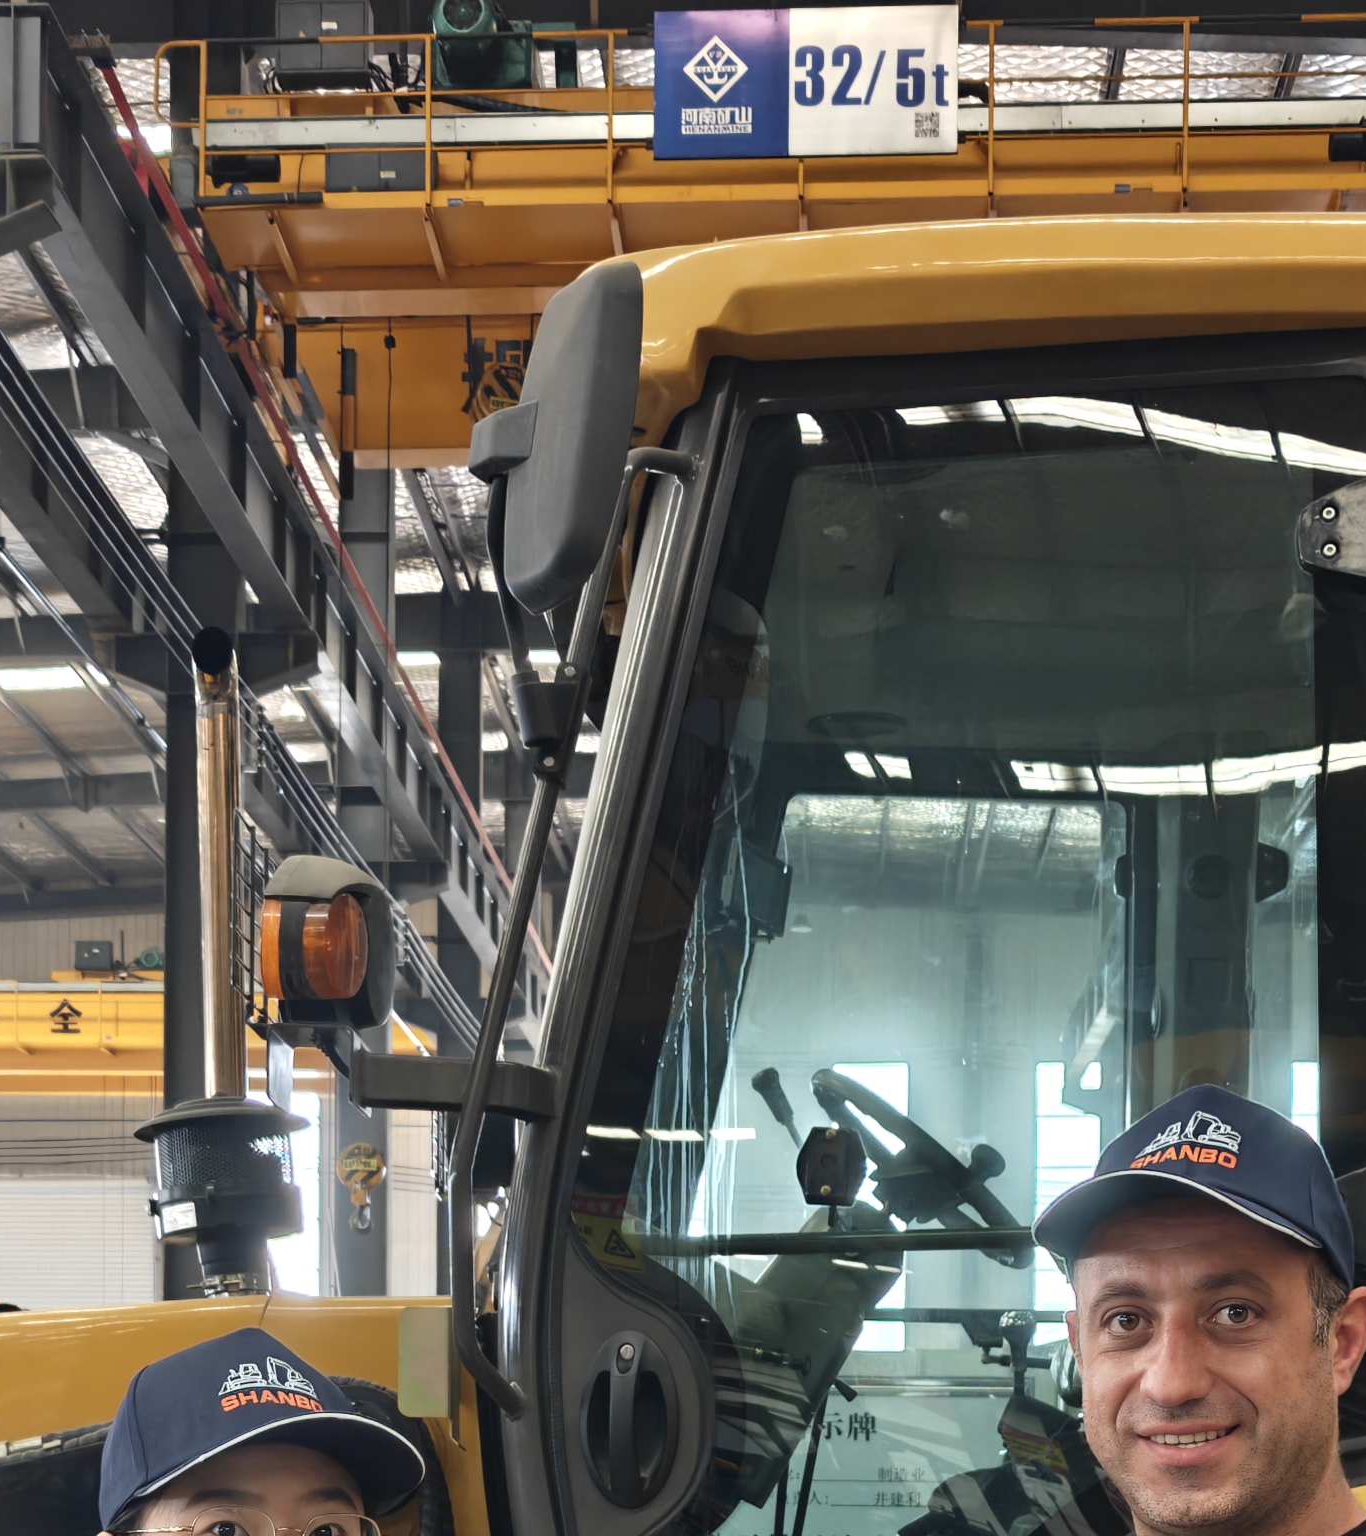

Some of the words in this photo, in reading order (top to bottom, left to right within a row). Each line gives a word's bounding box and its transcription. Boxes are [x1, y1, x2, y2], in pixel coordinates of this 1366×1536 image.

[794, 44, 950, 108] 32/5t
[1129, 1144, 1237, 1169] SHANBO
[221, 1389, 324, 1413] SHANBO
